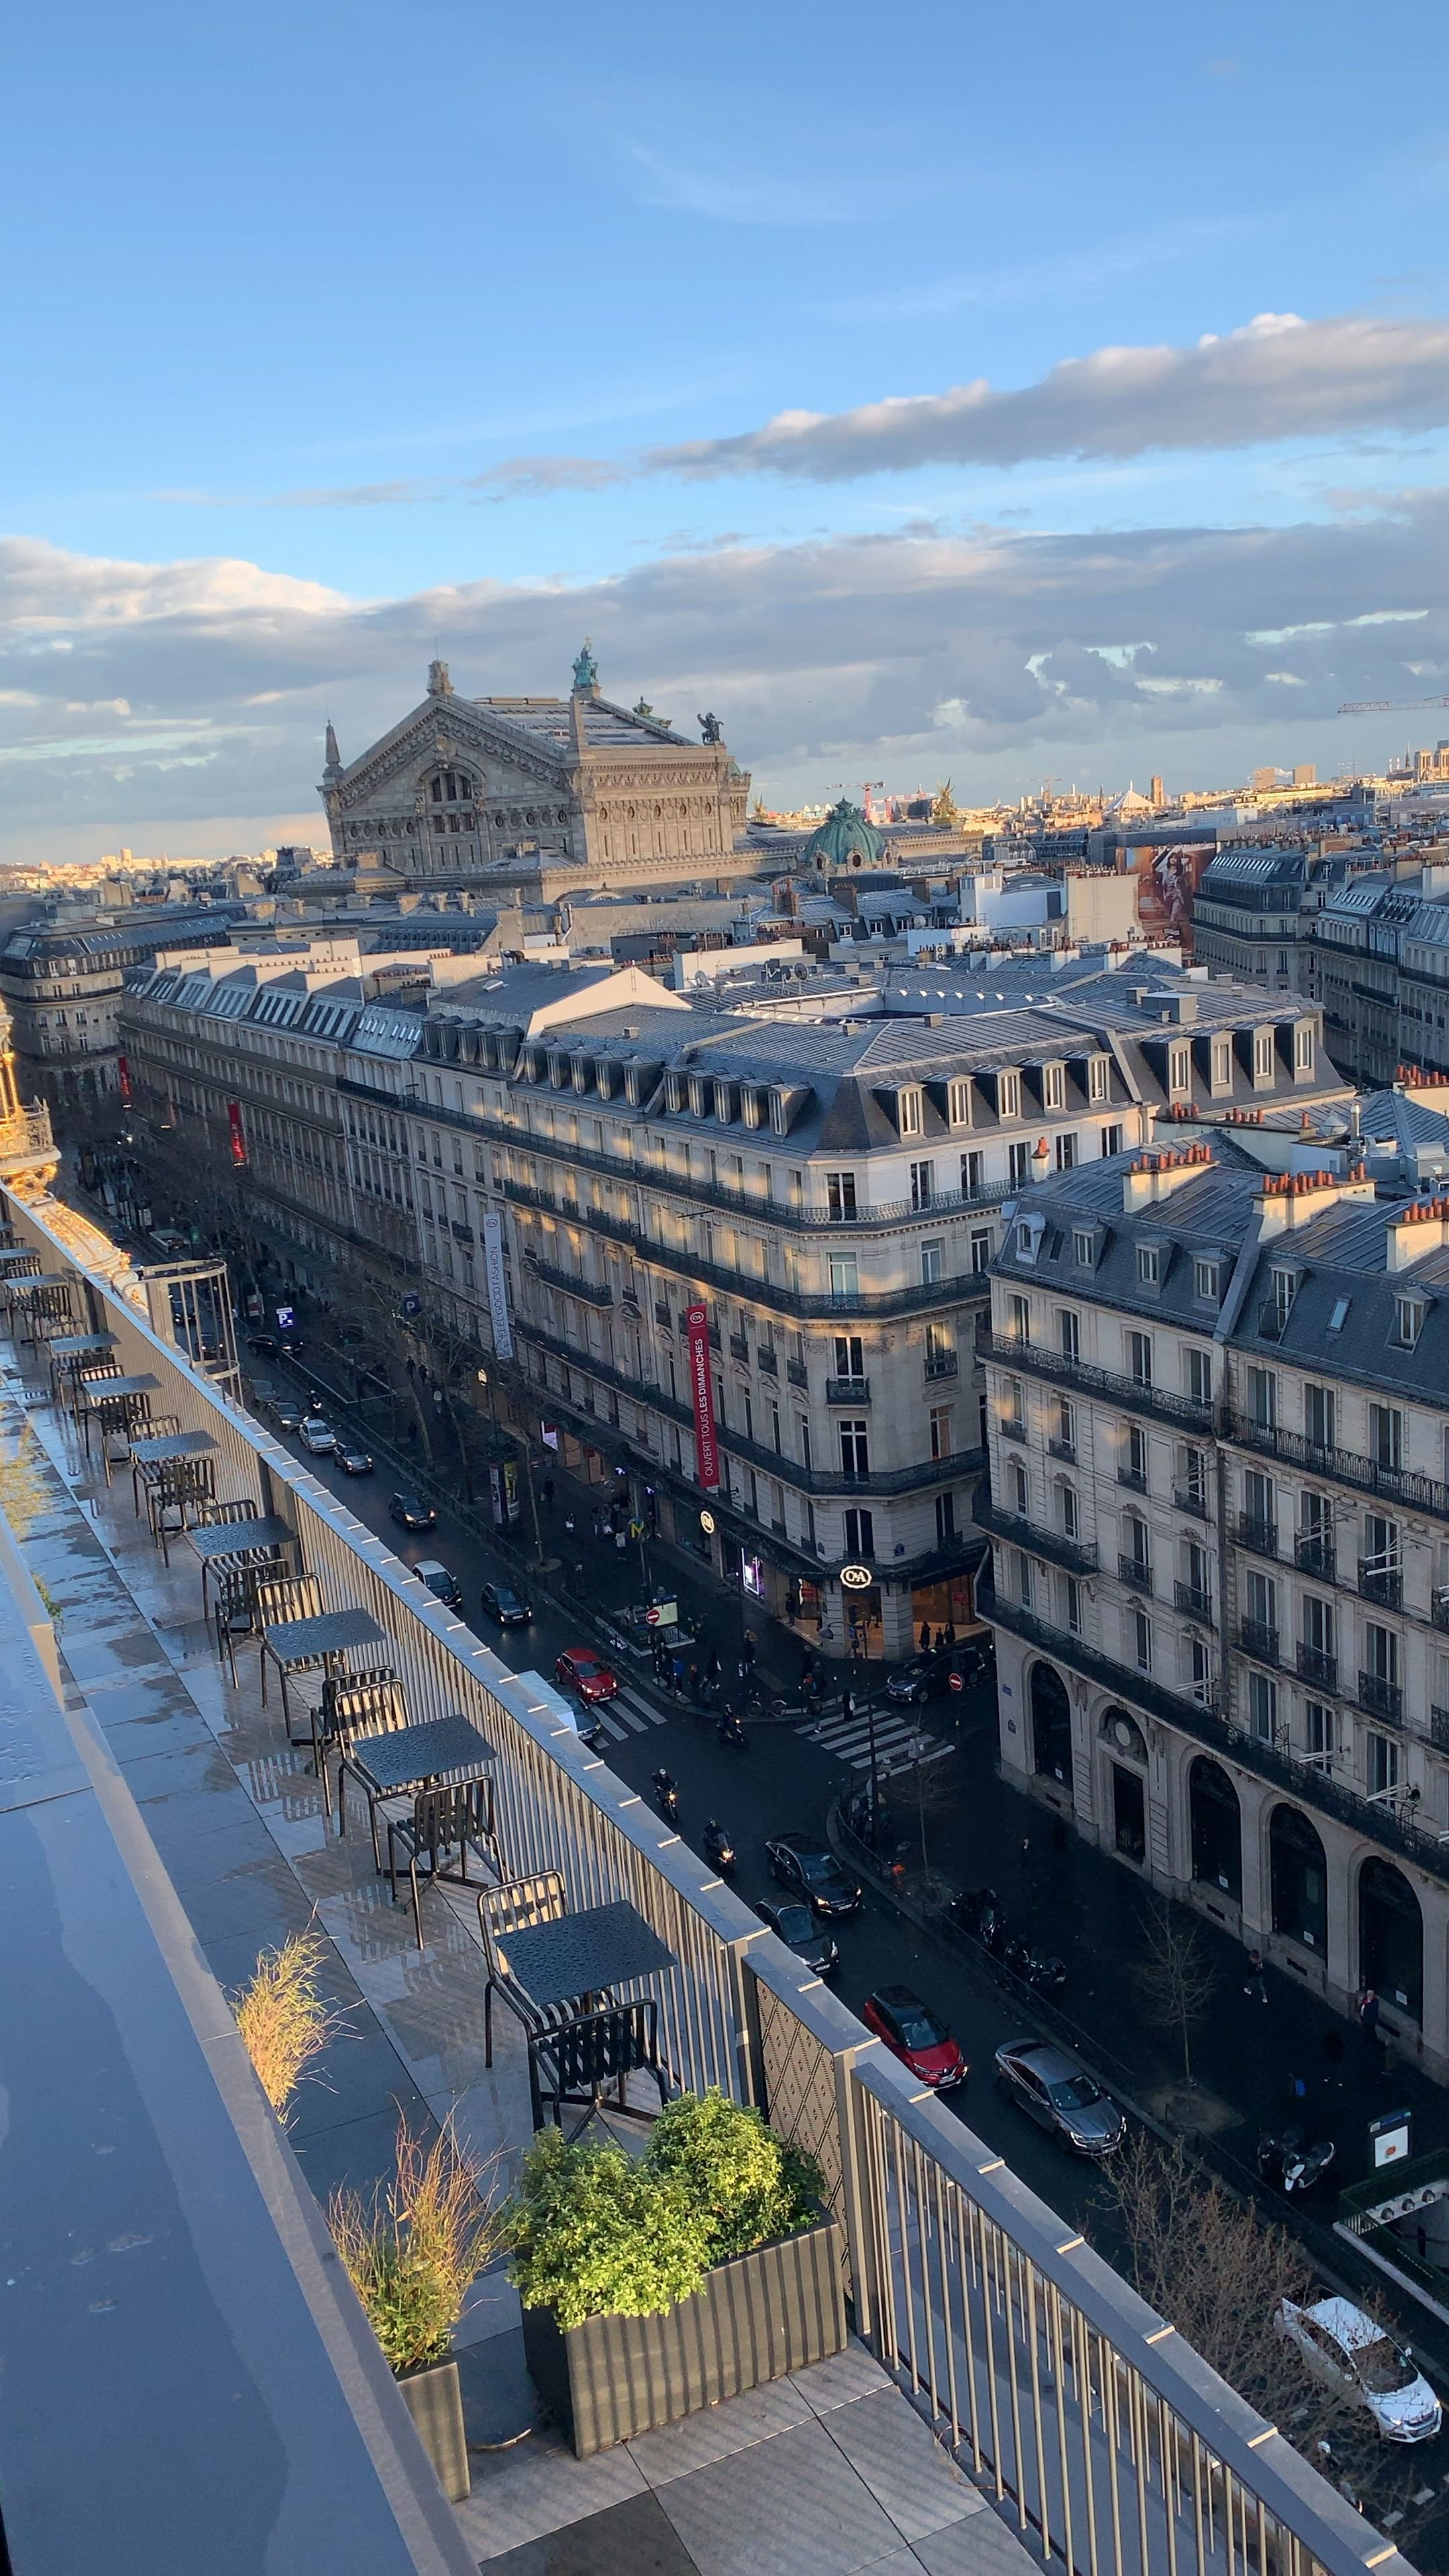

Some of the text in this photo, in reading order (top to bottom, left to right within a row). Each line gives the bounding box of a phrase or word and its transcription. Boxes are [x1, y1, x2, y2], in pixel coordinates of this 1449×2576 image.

[490, 1246, 500, 1285] FASHION
[493, 1287, 503, 1315] GOOD
[278, 1313, 288, 1324] P
[695, 1338, 706, 1395] DIMANCHES
[699, 1395, 708, 1413] LES
[700, 1413, 710, 1439] TOUS
[702, 1441, 713, 1477] OUVERT
[845, 1570, 867, 1582] C&A
